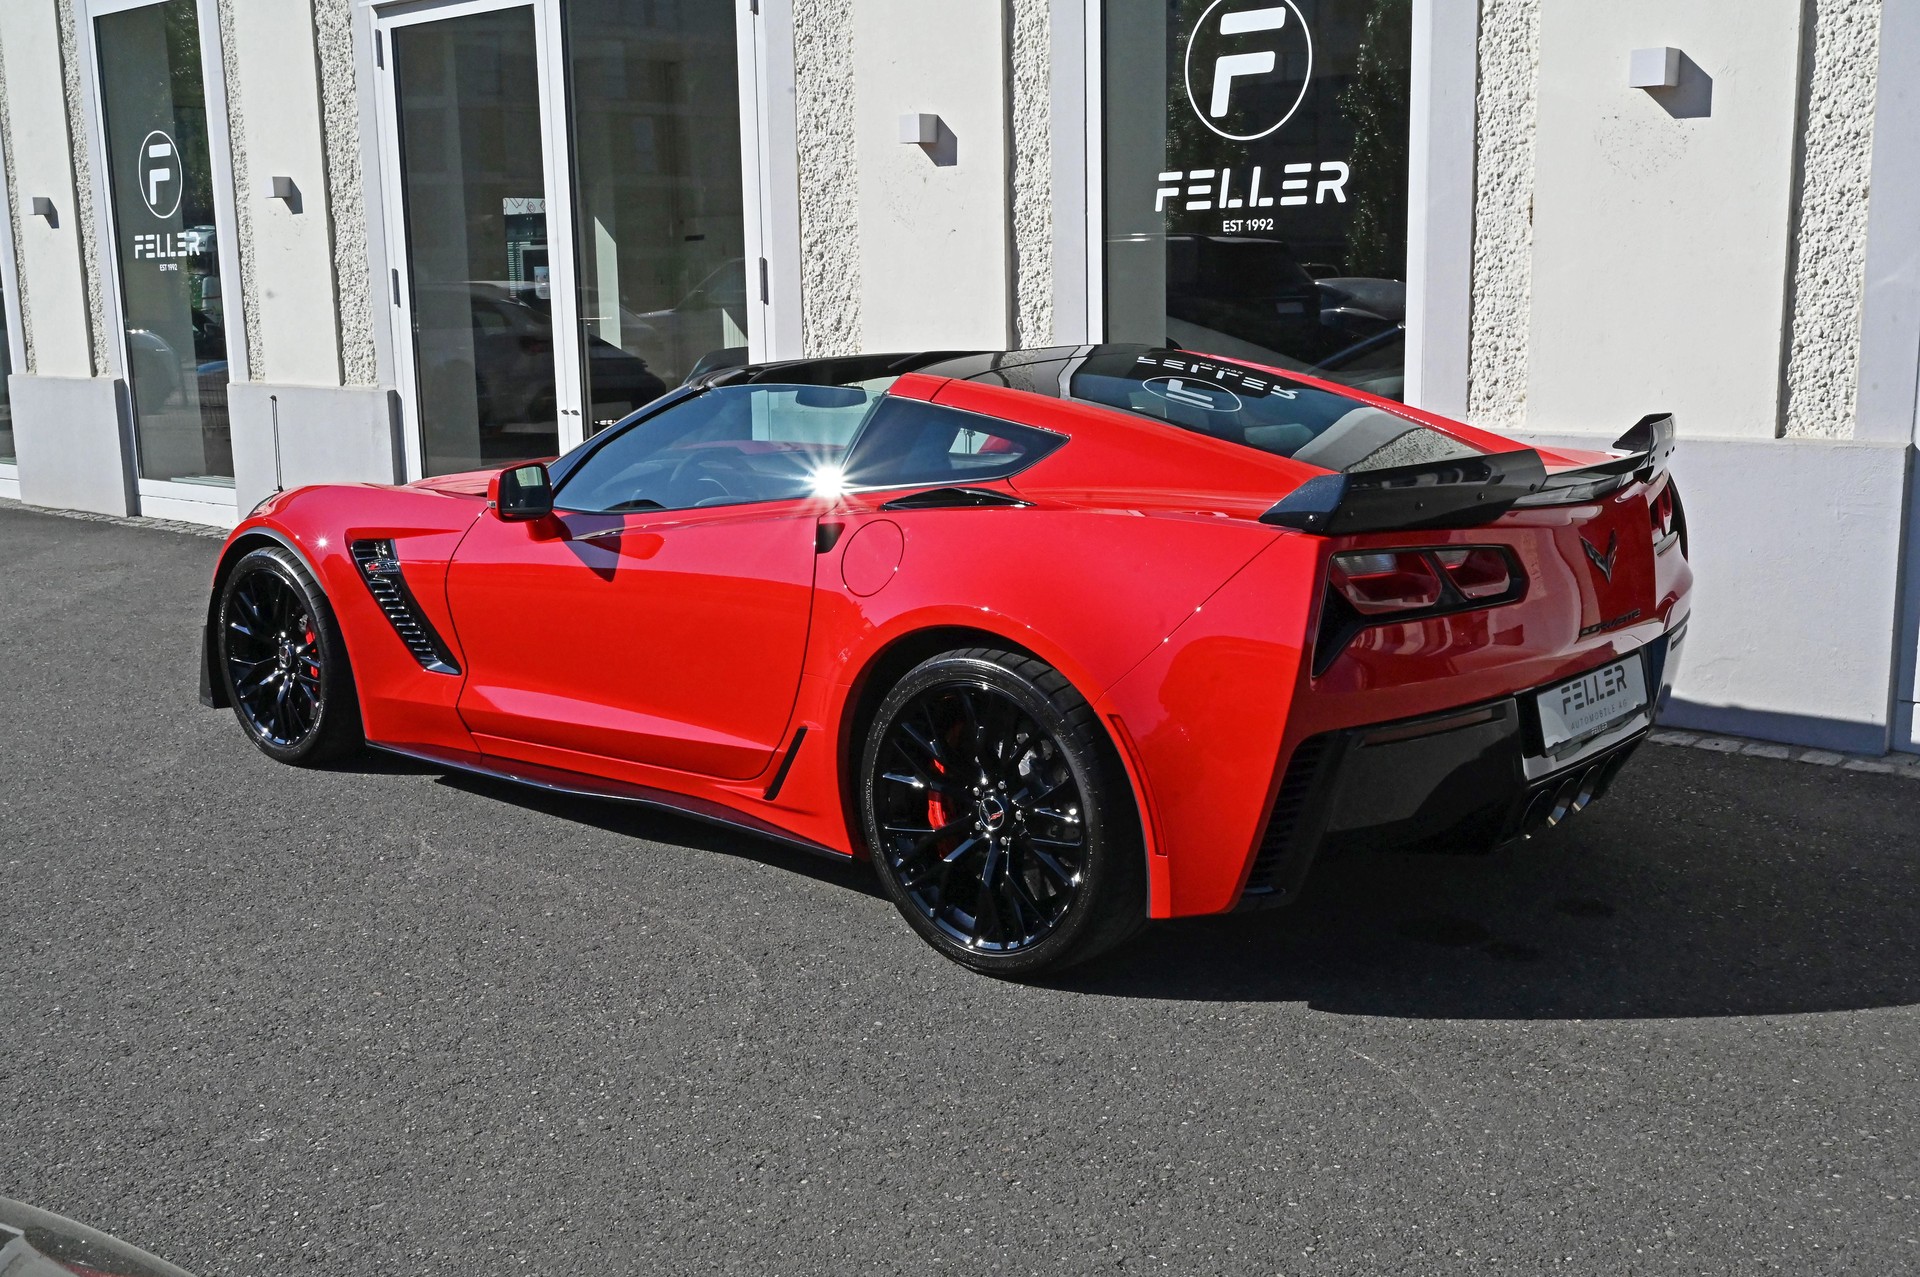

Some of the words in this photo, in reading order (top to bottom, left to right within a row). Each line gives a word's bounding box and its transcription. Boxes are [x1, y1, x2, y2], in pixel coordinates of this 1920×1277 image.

[1210, 6, 1286, 118] F
[149, 143, 171, 205] F
[1155, 161, 1349, 212] FELLER
[134, 231, 200, 259] FELLER
[1223, 220, 1243, 232] EST
[1246, 218, 1274, 231] 1992
[1561, 664, 1627, 715] FELLER
[1571, 704, 1616, 730] AUTOMOBILE
[1618, 698, 1628, 709] AG
